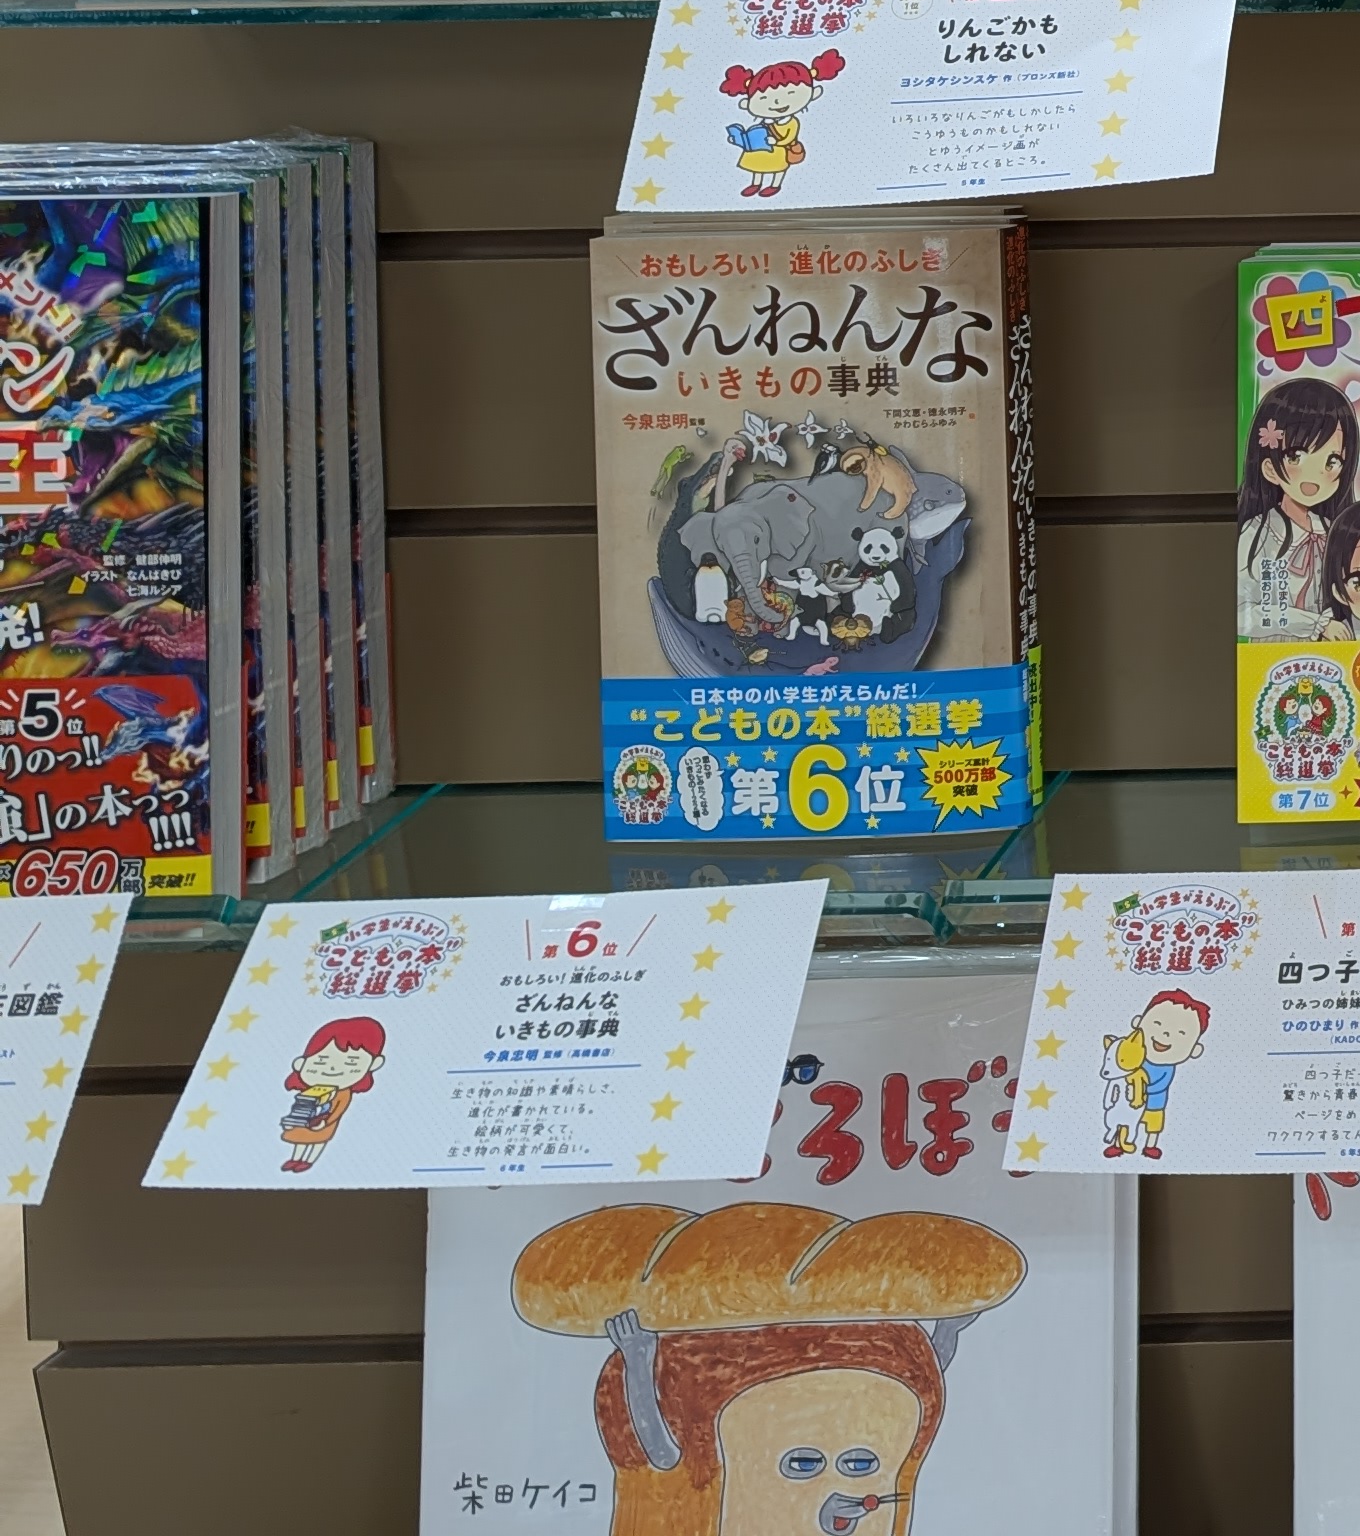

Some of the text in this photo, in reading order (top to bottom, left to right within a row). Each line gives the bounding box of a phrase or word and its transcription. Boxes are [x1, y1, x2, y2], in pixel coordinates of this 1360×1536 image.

[937, 14, 1060, 38] りんごかも
[942, 42, 1047, 64] しれない
[900, 73, 998, 88] ヨシタケシンスケ
[640, 249, 943, 277] おもしろい! 進化のふしぎ
[599, 284, 994, 391] ざんねんな
[677, 362, 900, 399] いきもの事典
[81, 570, 117, 581] イラスト
[690, 683, 918, 705] 日本中の小学生がえらんだ!
[933, 767, 997, 785] 500万部
[731, 744, 907, 832] 第6位
[952, 783, 979, 797] 突破
[1277, 790, 1330, 809] 第7位
[148, 873, 197, 889] 突破!!
[542, 921, 619, 959] 第6位
[500, 968, 647, 986] おもしろい! 進化のふしぎ
[514, 991, 619, 1013] ざんねんな
[494, 1017, 621, 1040] いきもの事典
[1282, 1019, 1345, 1031] ひのひまり
[453, 1472, 597, 1514] 柴田ケイコ
